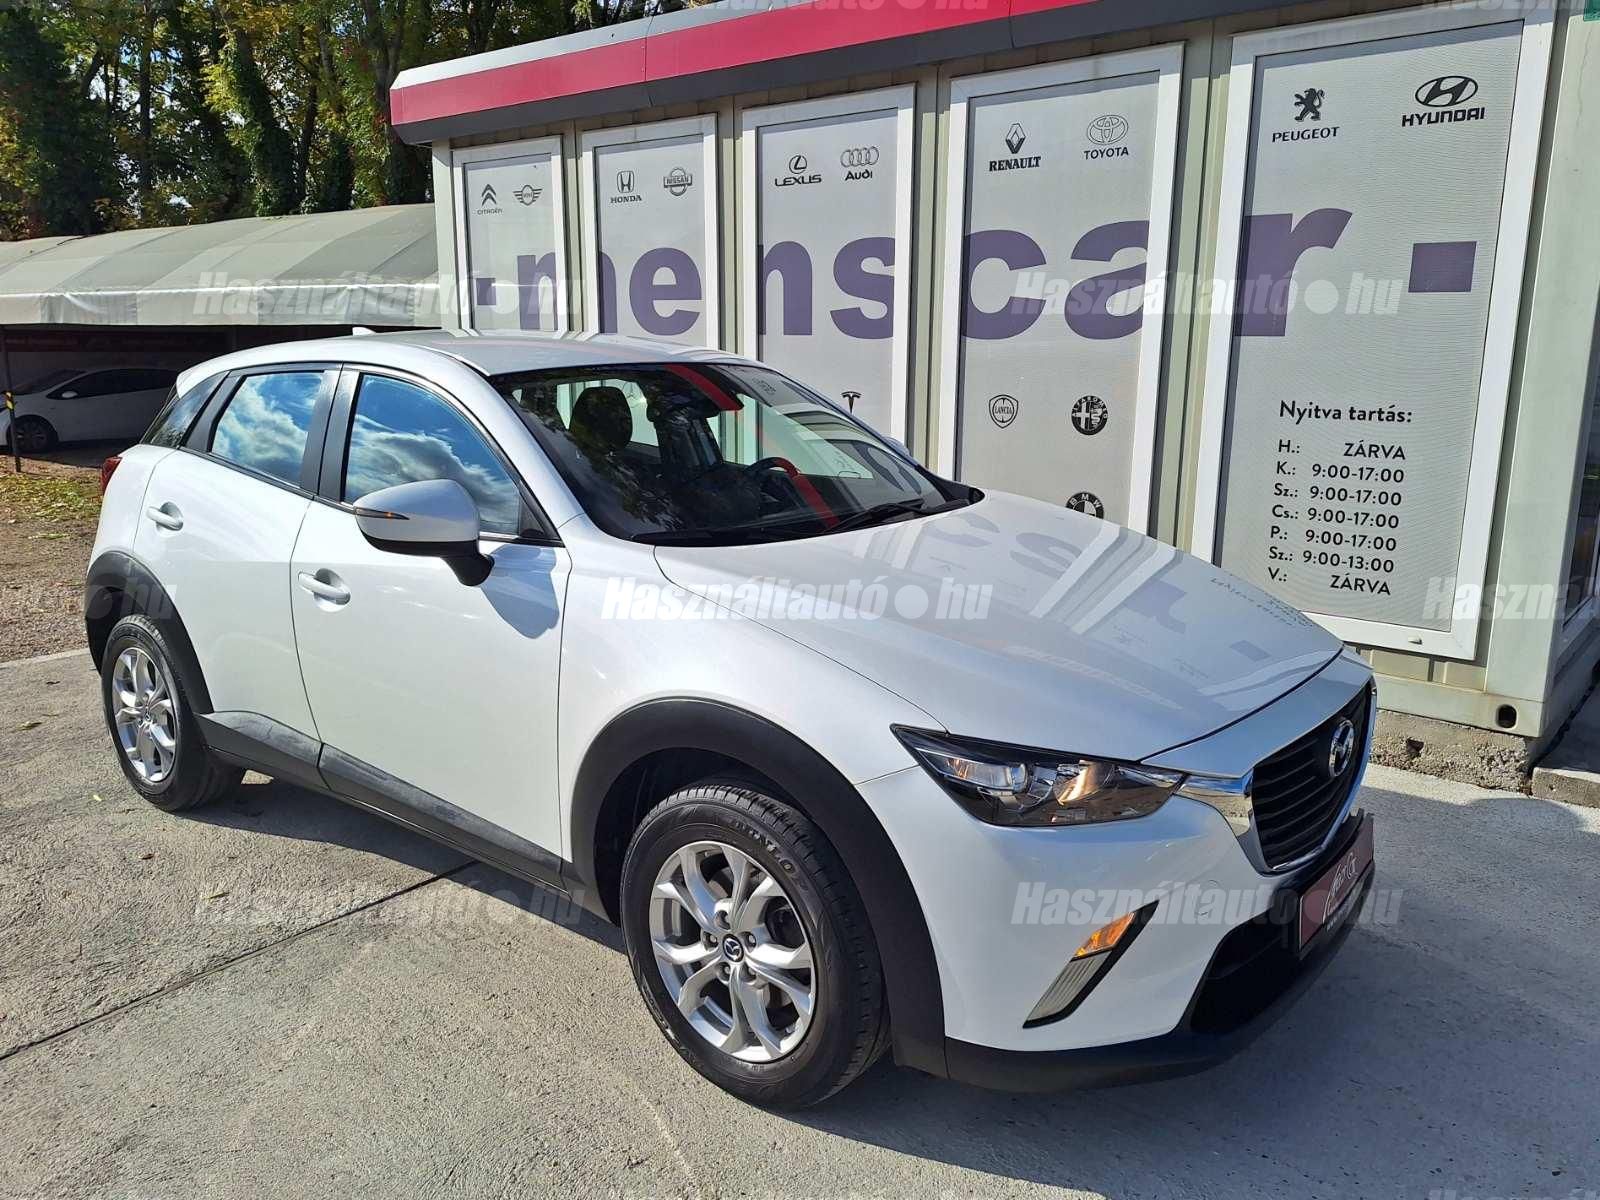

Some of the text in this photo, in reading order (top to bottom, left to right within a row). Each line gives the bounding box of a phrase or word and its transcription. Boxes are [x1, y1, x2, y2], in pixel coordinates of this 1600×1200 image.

[1401, 107, 1485, 127] HYUNDAI
[1272, 126, 1340, 143] PEUGEOT
[1083, 147, 1129, 160] TOYOTA
[989, 156, 1041, 172] RENAULT
[774, 174, 822, 187] LEXUS
[844, 169, 873, 181] Audi
[610, 194, 642, 204] HONDA
[1279, 400, 1413, 425] Nyitva tartás:
[1278, 439, 1406, 460] H.: ZÁRVA
[1276, 461, 1404, 483] K.: 9:00-17:00
[1069, 493, 1102, 508] BMW
[1273, 483, 1402, 506] Sz.: 9:00-17:00
[1272, 504, 1399, 529] Cs.: 9:00-17:00
[1270, 526, 1397, 551] P.: 9:00-17:00
[1269, 546, 1394, 573] Sz.: 9:00-13:00
[1268, 567, 1391, 595] V.: ZÁRVA
